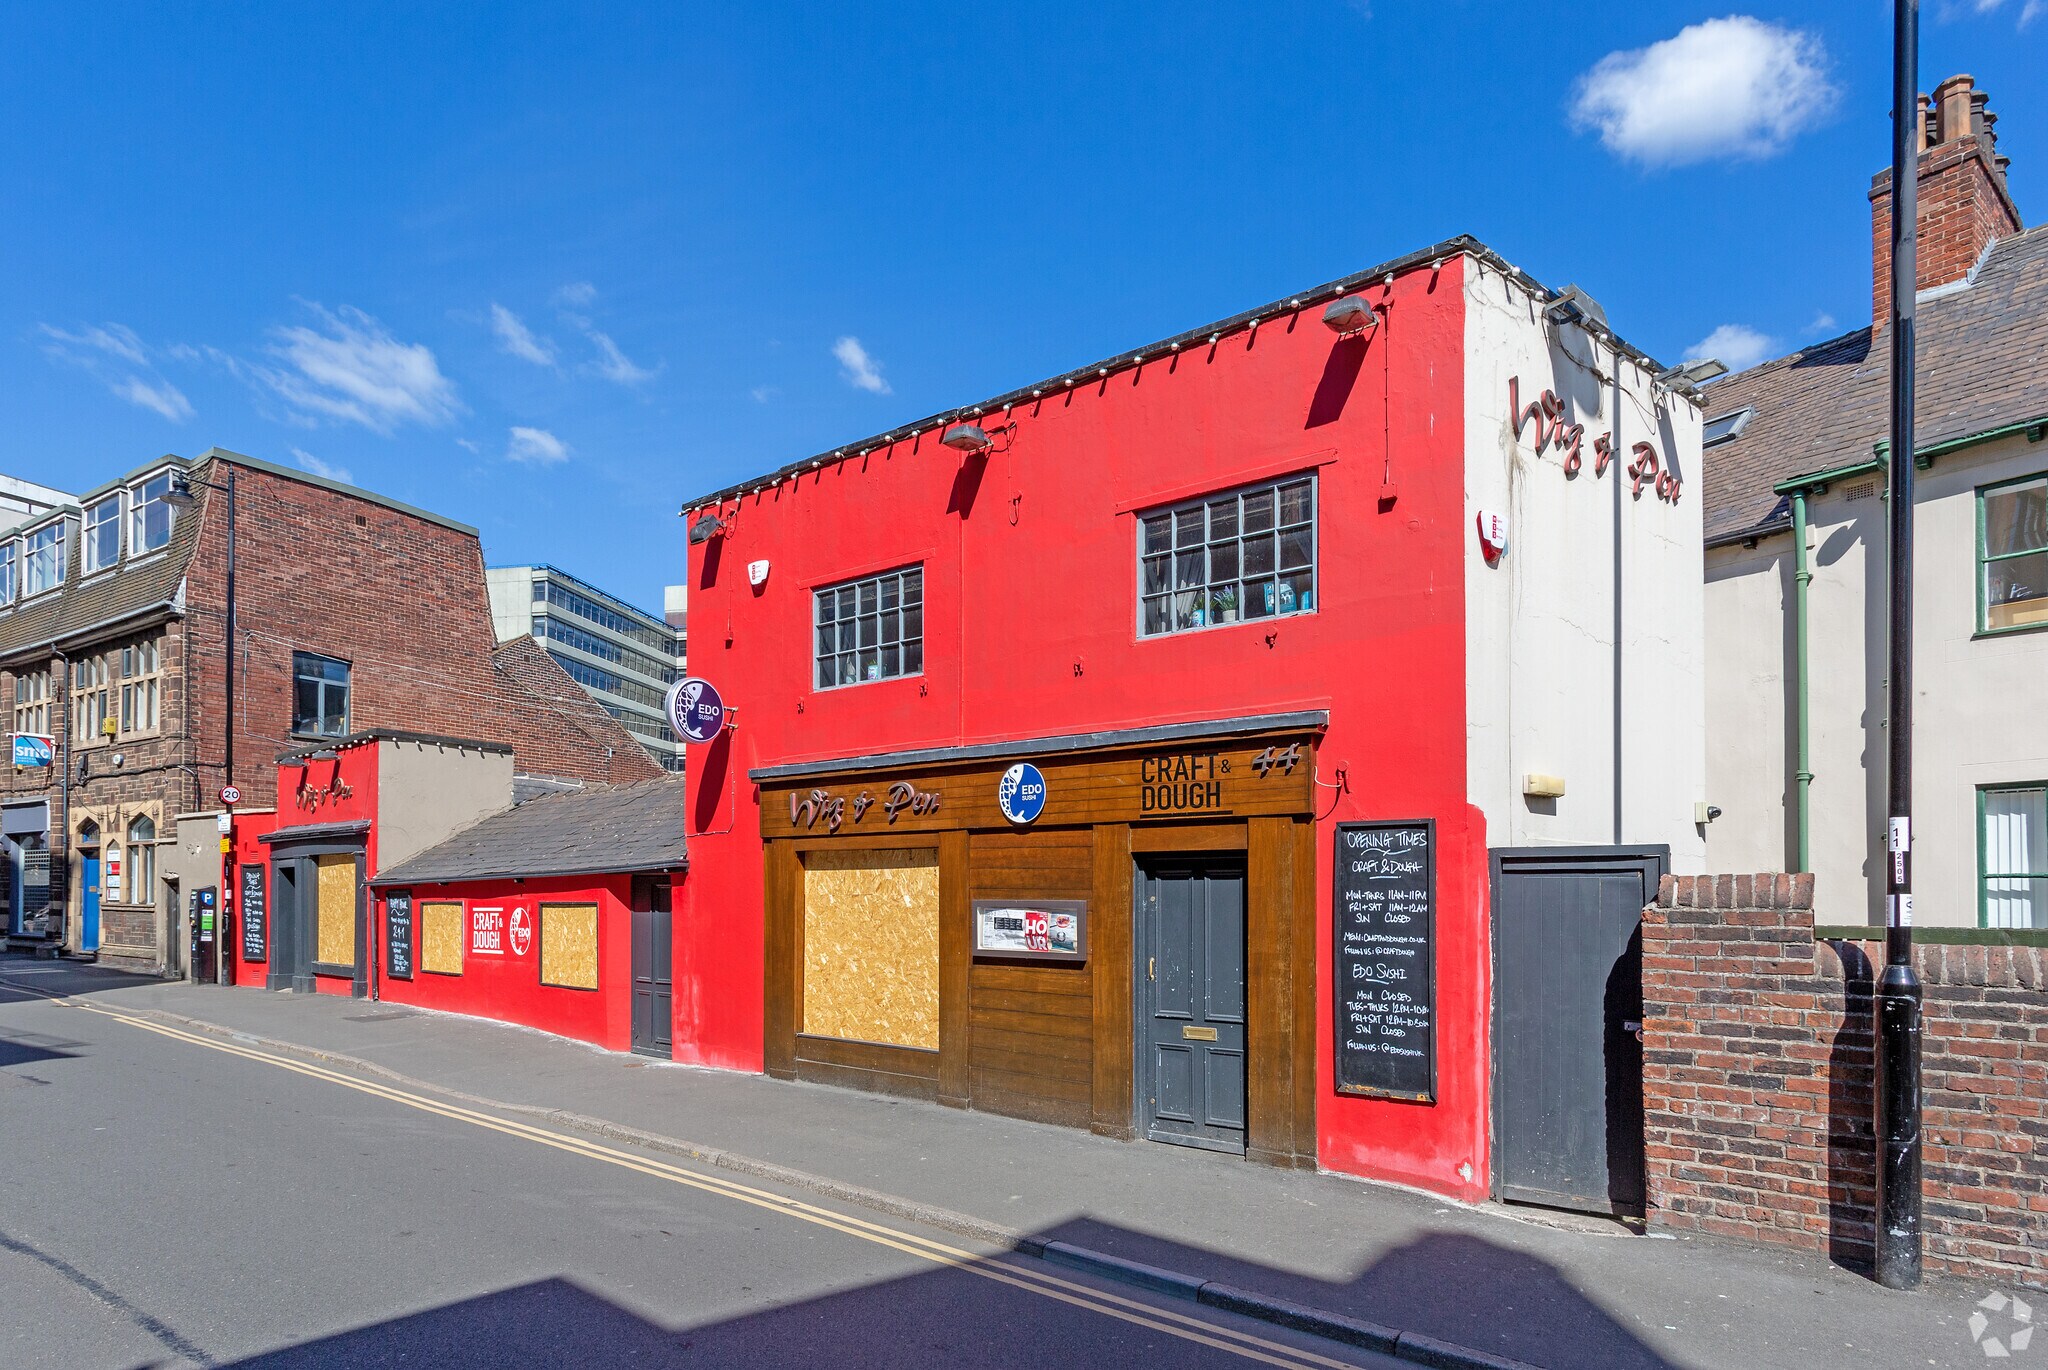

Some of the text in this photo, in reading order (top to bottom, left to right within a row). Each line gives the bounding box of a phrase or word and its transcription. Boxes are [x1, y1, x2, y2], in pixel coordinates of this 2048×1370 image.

[1509, 375, 1585, 479] Wig
[1628, 440, 1682, 505] Pen
[698, 704, 720, 716] EDO
[16, 745, 49, 759] smc
[1251, 743, 1302, 778] 44
[1141, 753, 1232, 783] CRAFT &
[224, 790, 239, 799] 20
[1021, 783, 1042, 795] EDO
[1141, 781, 1221, 812] DOUGH
[789, 789, 845, 833] Wig
[884, 781, 940, 824] Pen
[1347, 831, 1428, 848] OPENING TIMES
[1352, 860, 1378, 873] CRAFT
[1390, 860, 1423, 874] DOUGH
[204, 893, 212, 903] P
[1349, 901, 1382, 912] FRI+SAT
[473, 912, 499, 931] CRAFT
[1384, 912, 1411, 923] CLOSED
[518, 927, 530, 938] EDO
[473, 930, 500, 949] DOUGH
[1352, 962, 1408, 979] EDO SUSHI
[1356, 989, 1412, 1002] MON CLOSED
[1346, 1001, 1389, 1012] TUES-THURS
[1350, 1013, 1382, 1024] FRI+SAT
[1355, 1024, 1406, 1037] SUN CLOSED
